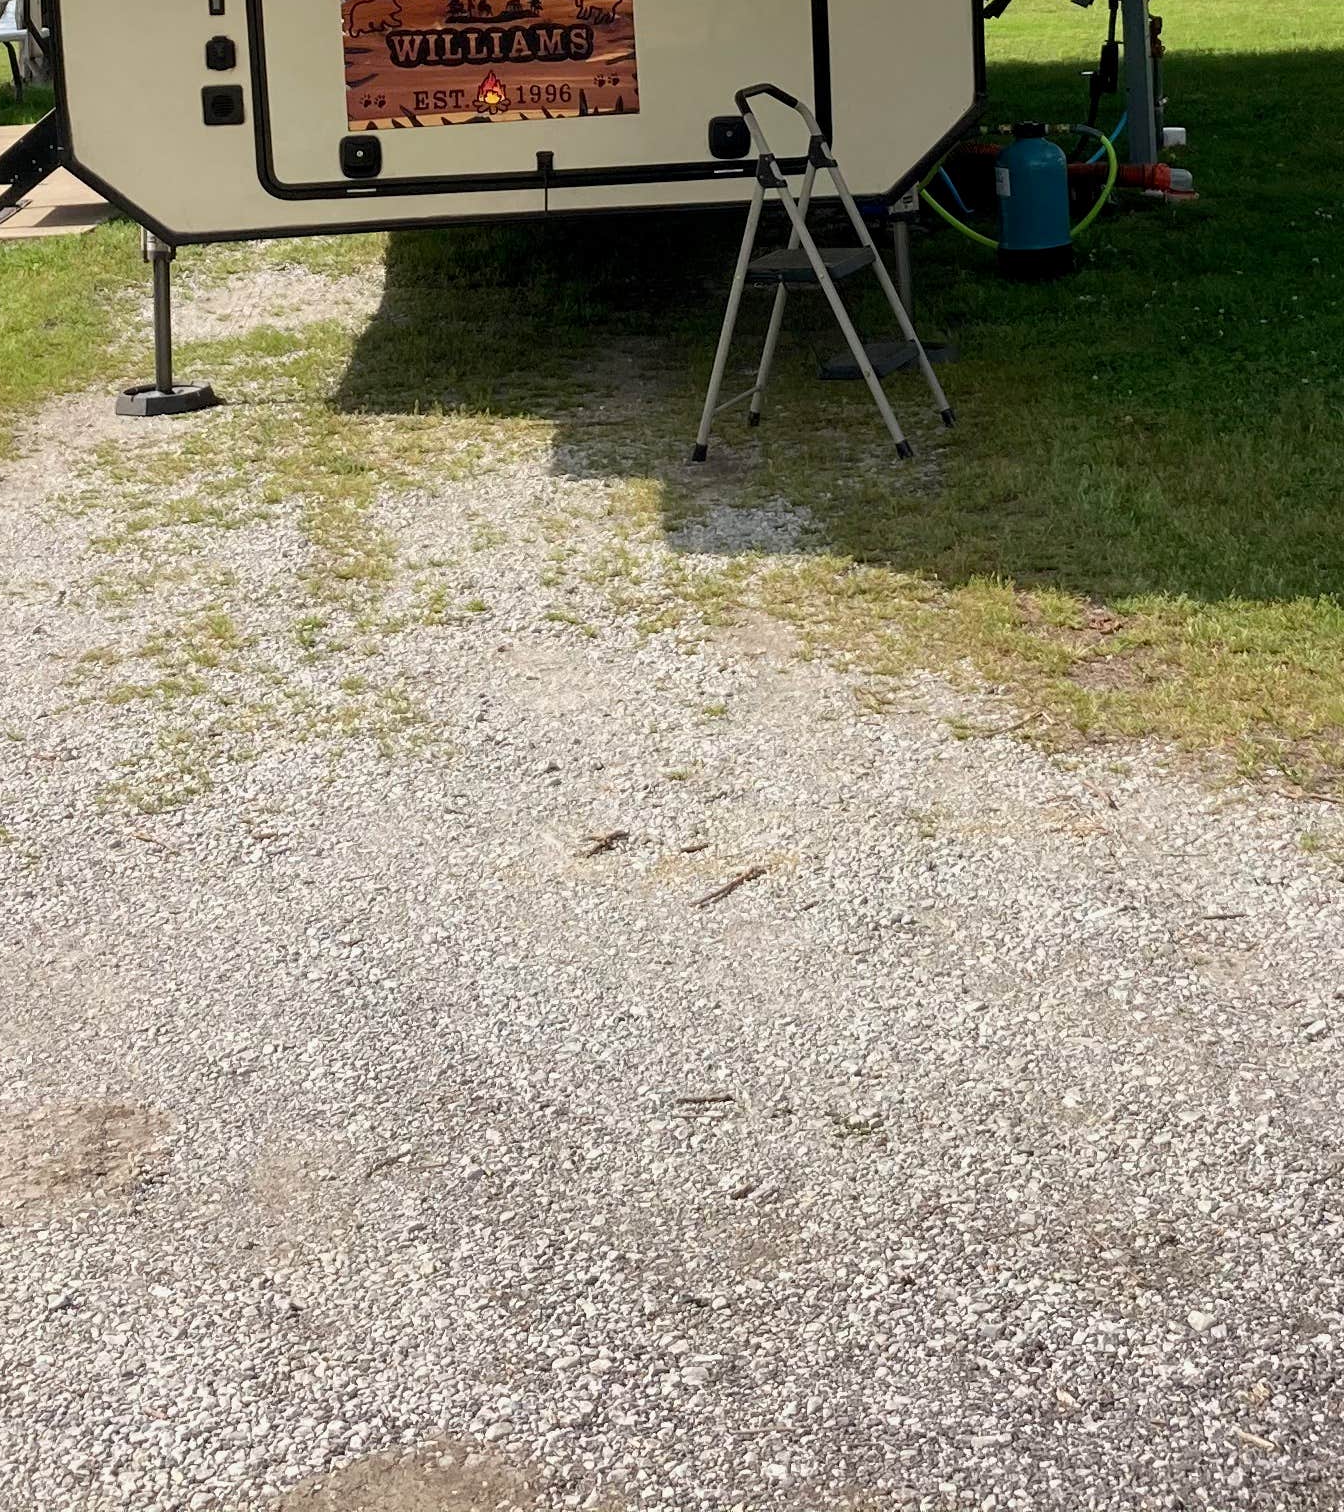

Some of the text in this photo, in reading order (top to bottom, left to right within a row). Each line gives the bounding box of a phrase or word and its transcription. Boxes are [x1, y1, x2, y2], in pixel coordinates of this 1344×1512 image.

[390, 28, 590, 63] WILLIAMS
[413, 83, 573, 111] EST. 1996
